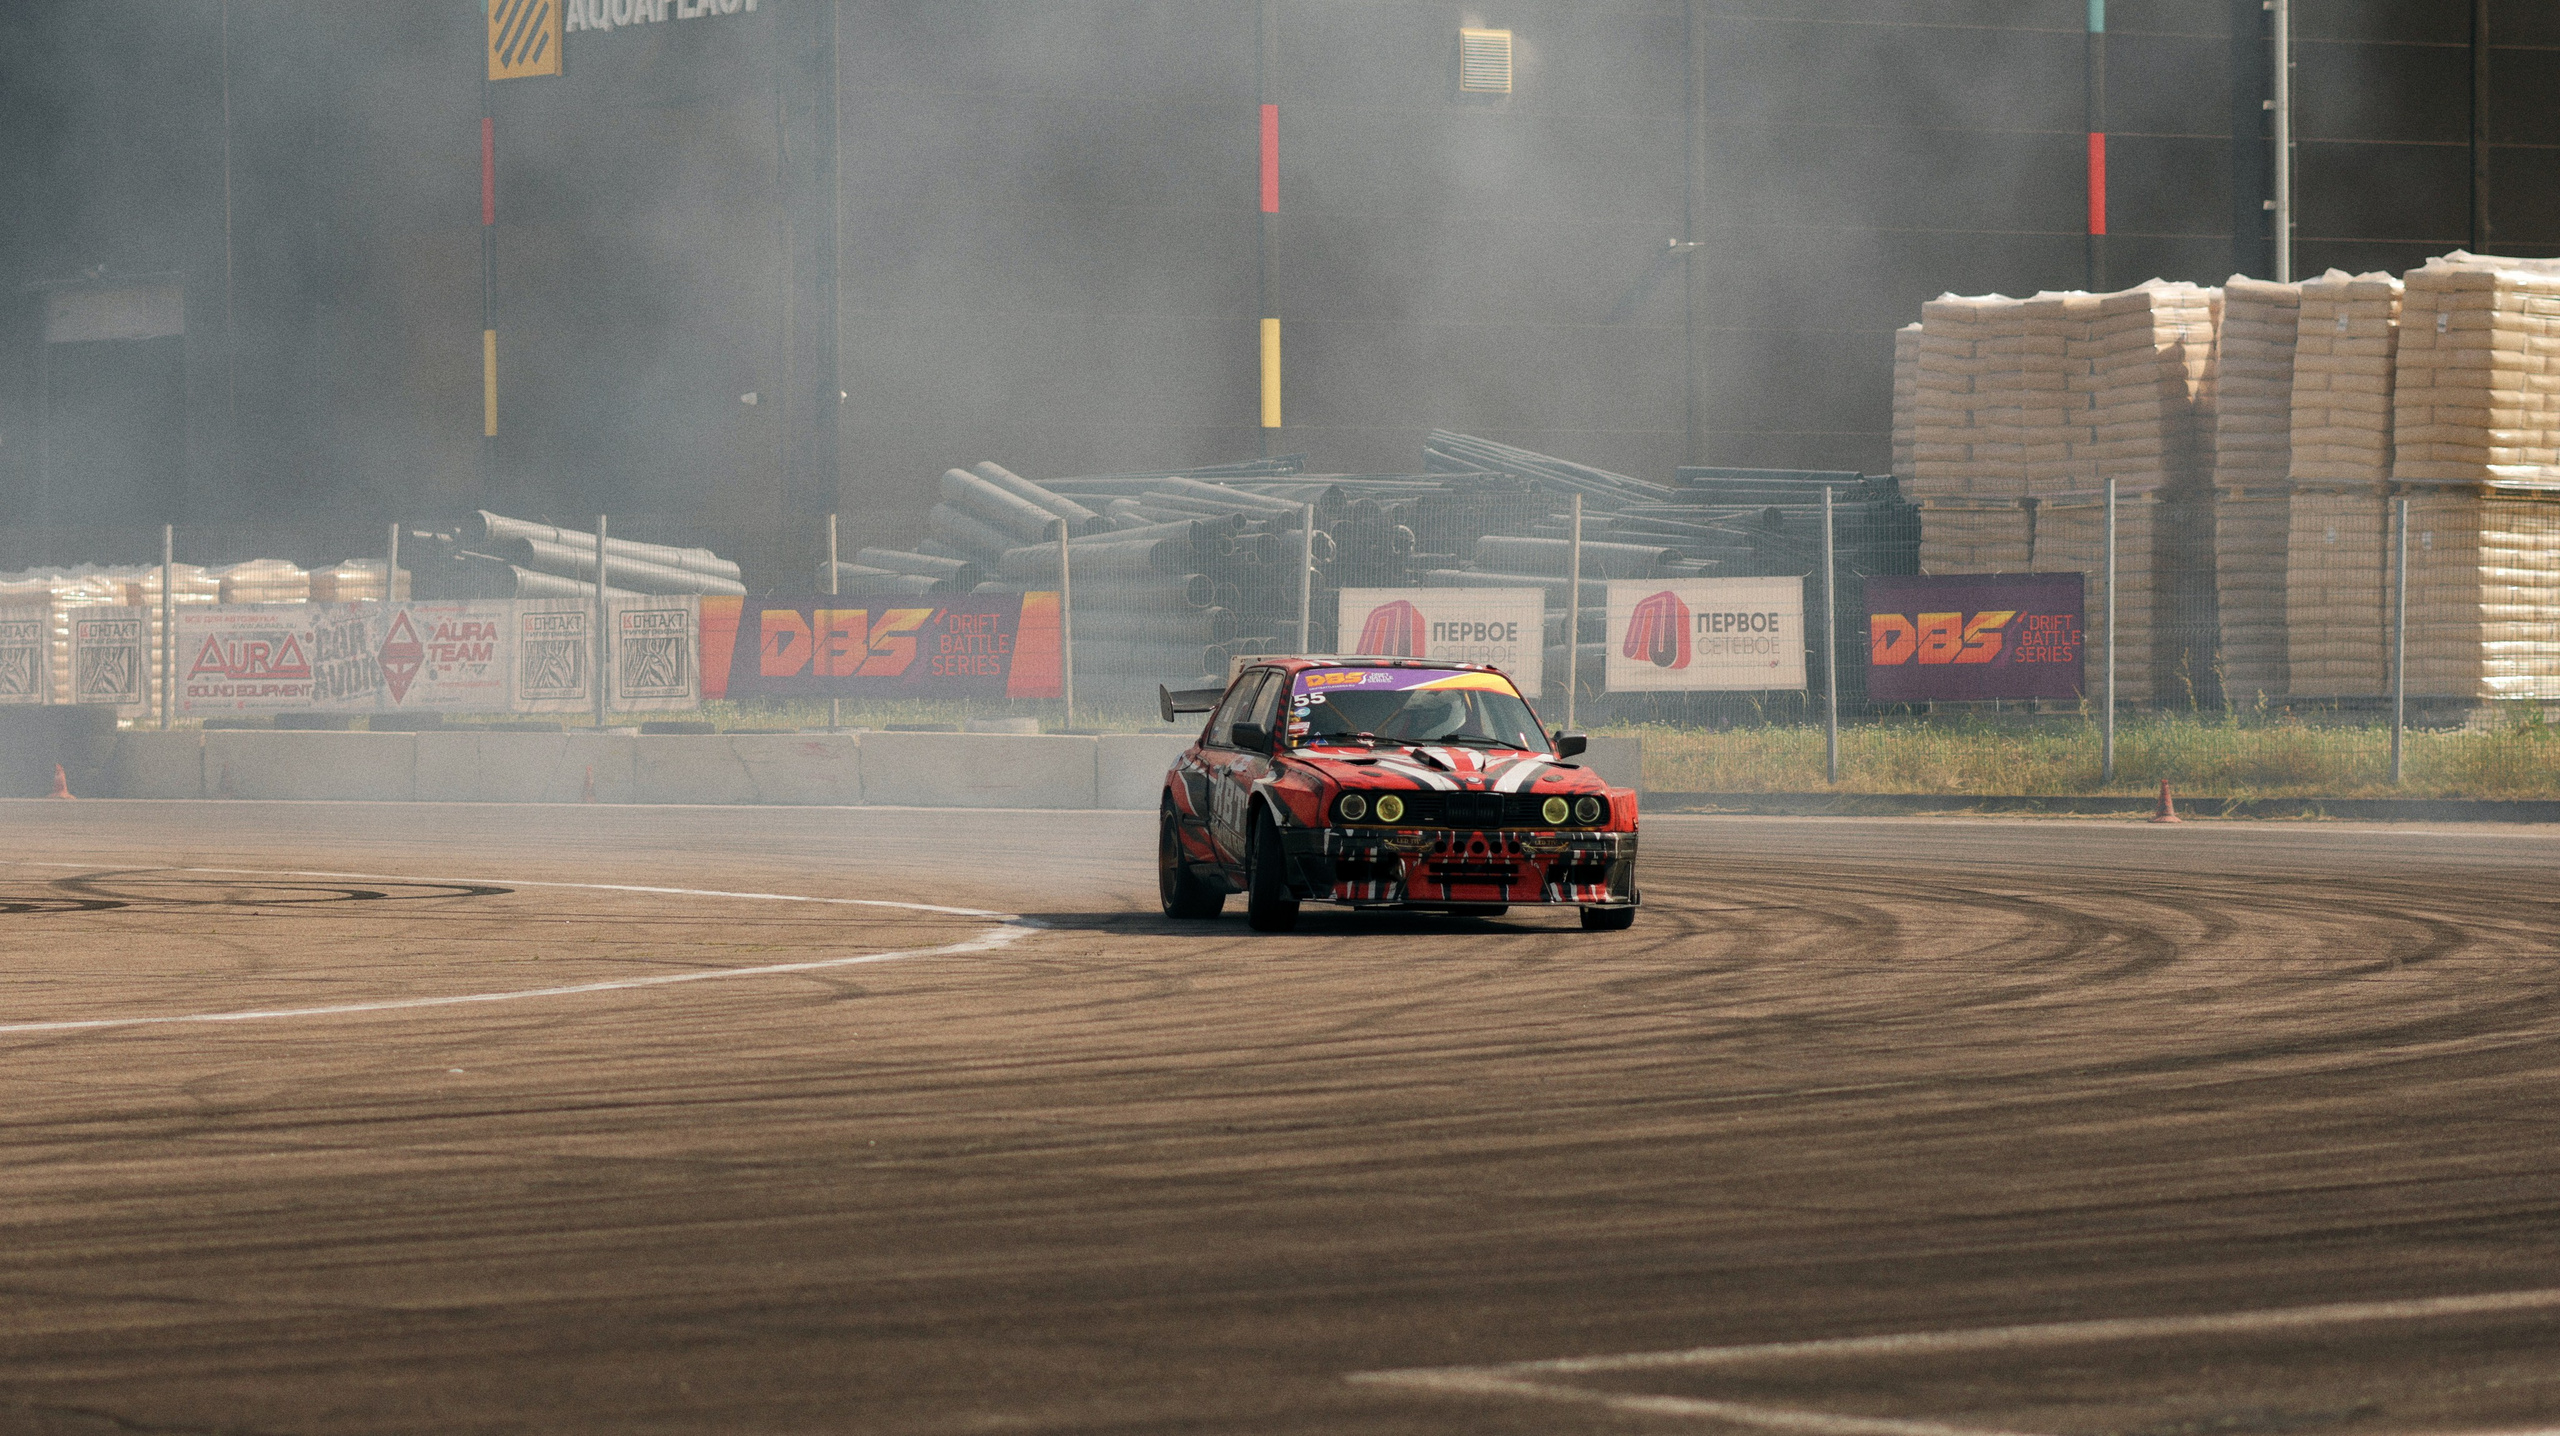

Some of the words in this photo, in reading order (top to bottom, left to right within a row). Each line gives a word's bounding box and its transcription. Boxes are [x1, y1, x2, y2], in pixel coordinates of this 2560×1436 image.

[566, 0, 758, 33] AQUAPLA
[525, 616, 582, 631] КОНТАКТ
[622, 613, 685, 629] КОНТАКТ
[949, 613, 1000, 633] DRIFT
[1697, 612, 1779, 633] ПЕРВОЕ
[2028, 614, 2073, 631] DRIFT
[0, 625, 38, 638] НТАКТ
[80, 624, 138, 638] КОНТАКТ
[432, 621, 499, 642] AURA
[1433, 621, 1518, 642] ПЕРВОЕ
[1870, 610, 2017, 666] DBS
[2022, 630, 2081, 646] BATTLE
[760, 607, 934, 677] DBS
[940, 634, 1010, 655] BATTLE
[1697, 636, 1780, 655] СЕТЕВОЕ
[187, 632, 314, 682] AURA
[427, 642, 494, 662] TEAM
[1432, 645, 1517, 664] СЕТЕВОЕ
[2015, 646, 2073, 662] SERIES
[932, 655, 1001, 677] SERIES
[1305, 671, 1366, 688] DBS
[236, 683, 313, 697] EQUIPMENT
[1294, 691, 1327, 707] 55
